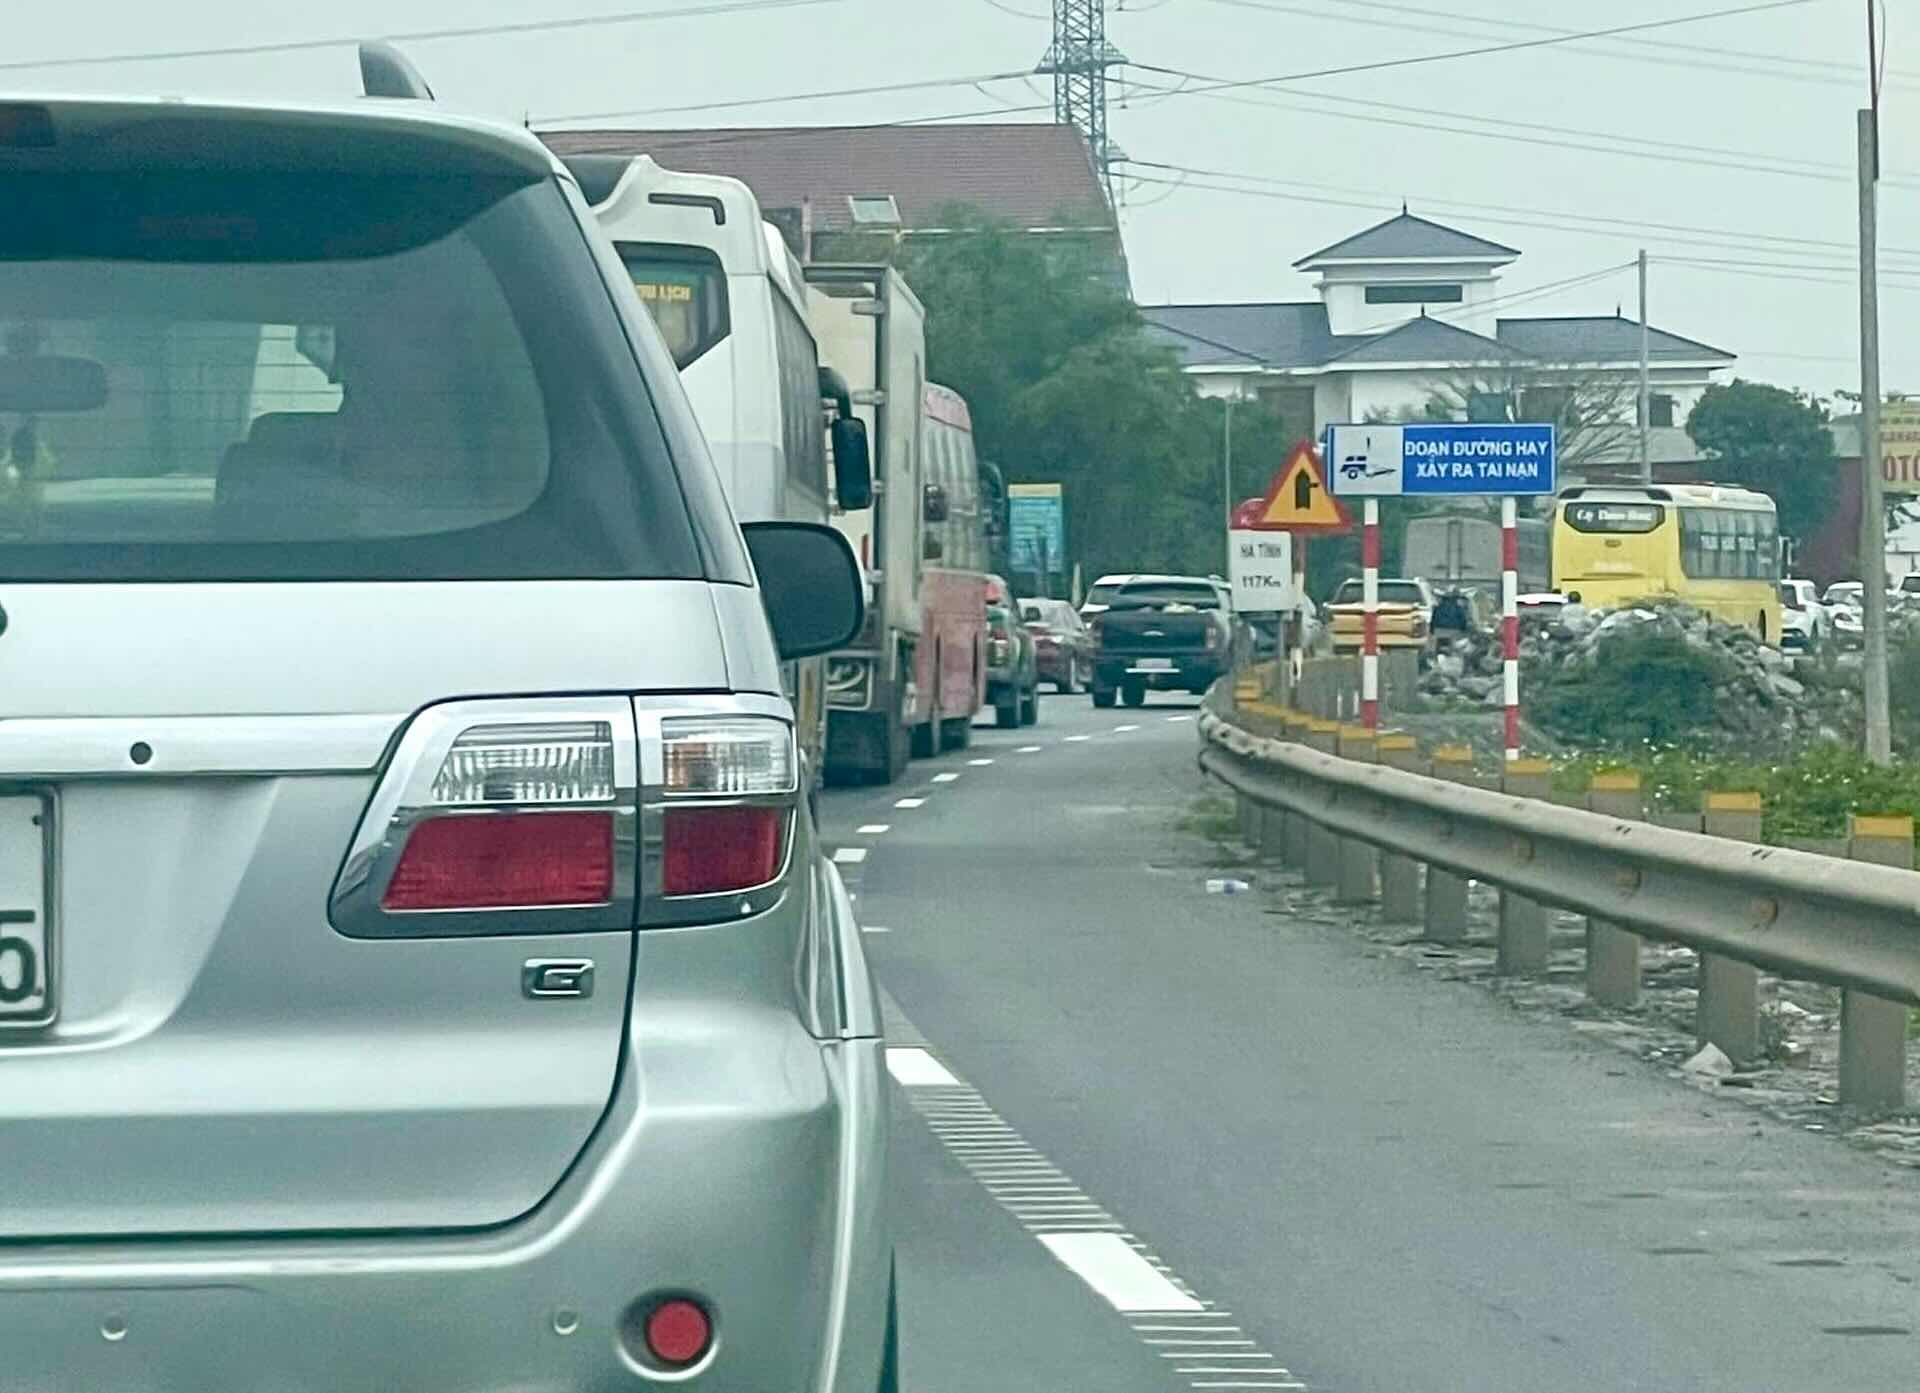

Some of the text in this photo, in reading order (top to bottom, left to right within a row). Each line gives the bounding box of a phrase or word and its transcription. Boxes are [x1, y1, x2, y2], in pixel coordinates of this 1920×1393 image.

[1515, 440, 1549, 456] HAY
[1452, 463, 1474, 478] RA
[1477, 463, 1503, 478] TAI
[1505, 463, 1539, 480] NẠN
